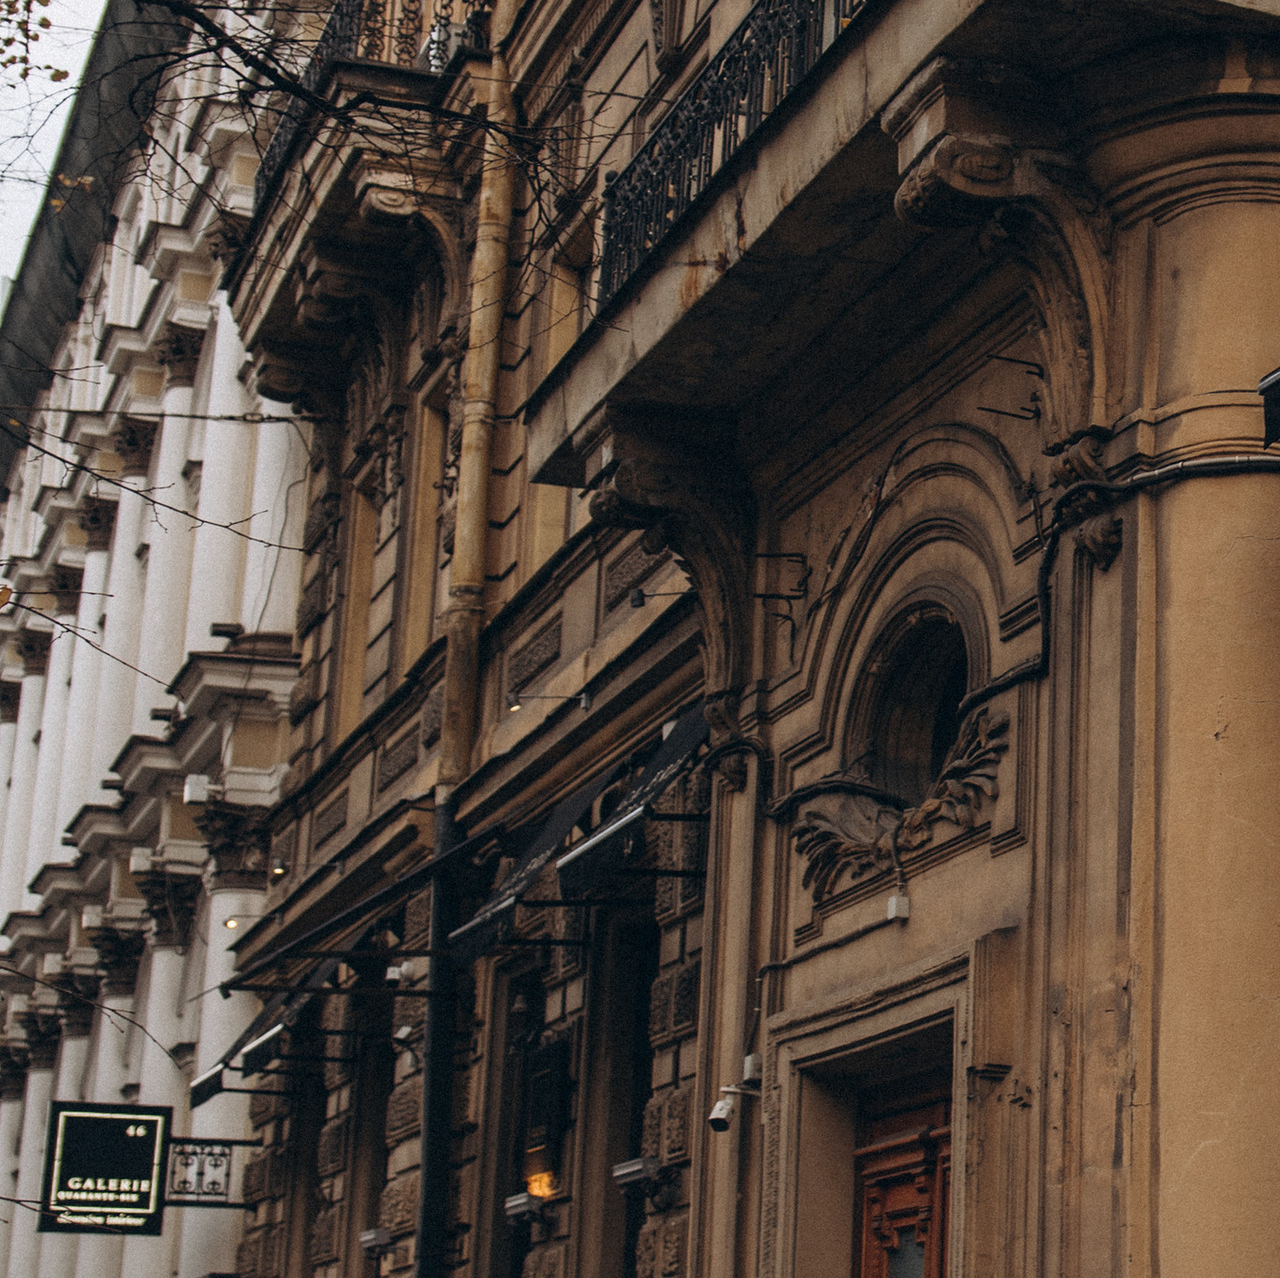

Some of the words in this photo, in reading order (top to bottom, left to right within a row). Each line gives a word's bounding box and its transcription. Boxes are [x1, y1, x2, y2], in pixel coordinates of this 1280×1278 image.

[126, 1125, 147, 1137] 46
[68, 1177, 151, 1192] GALERIE
[57, 1191, 139, 1202] QUARANTE-SIX
